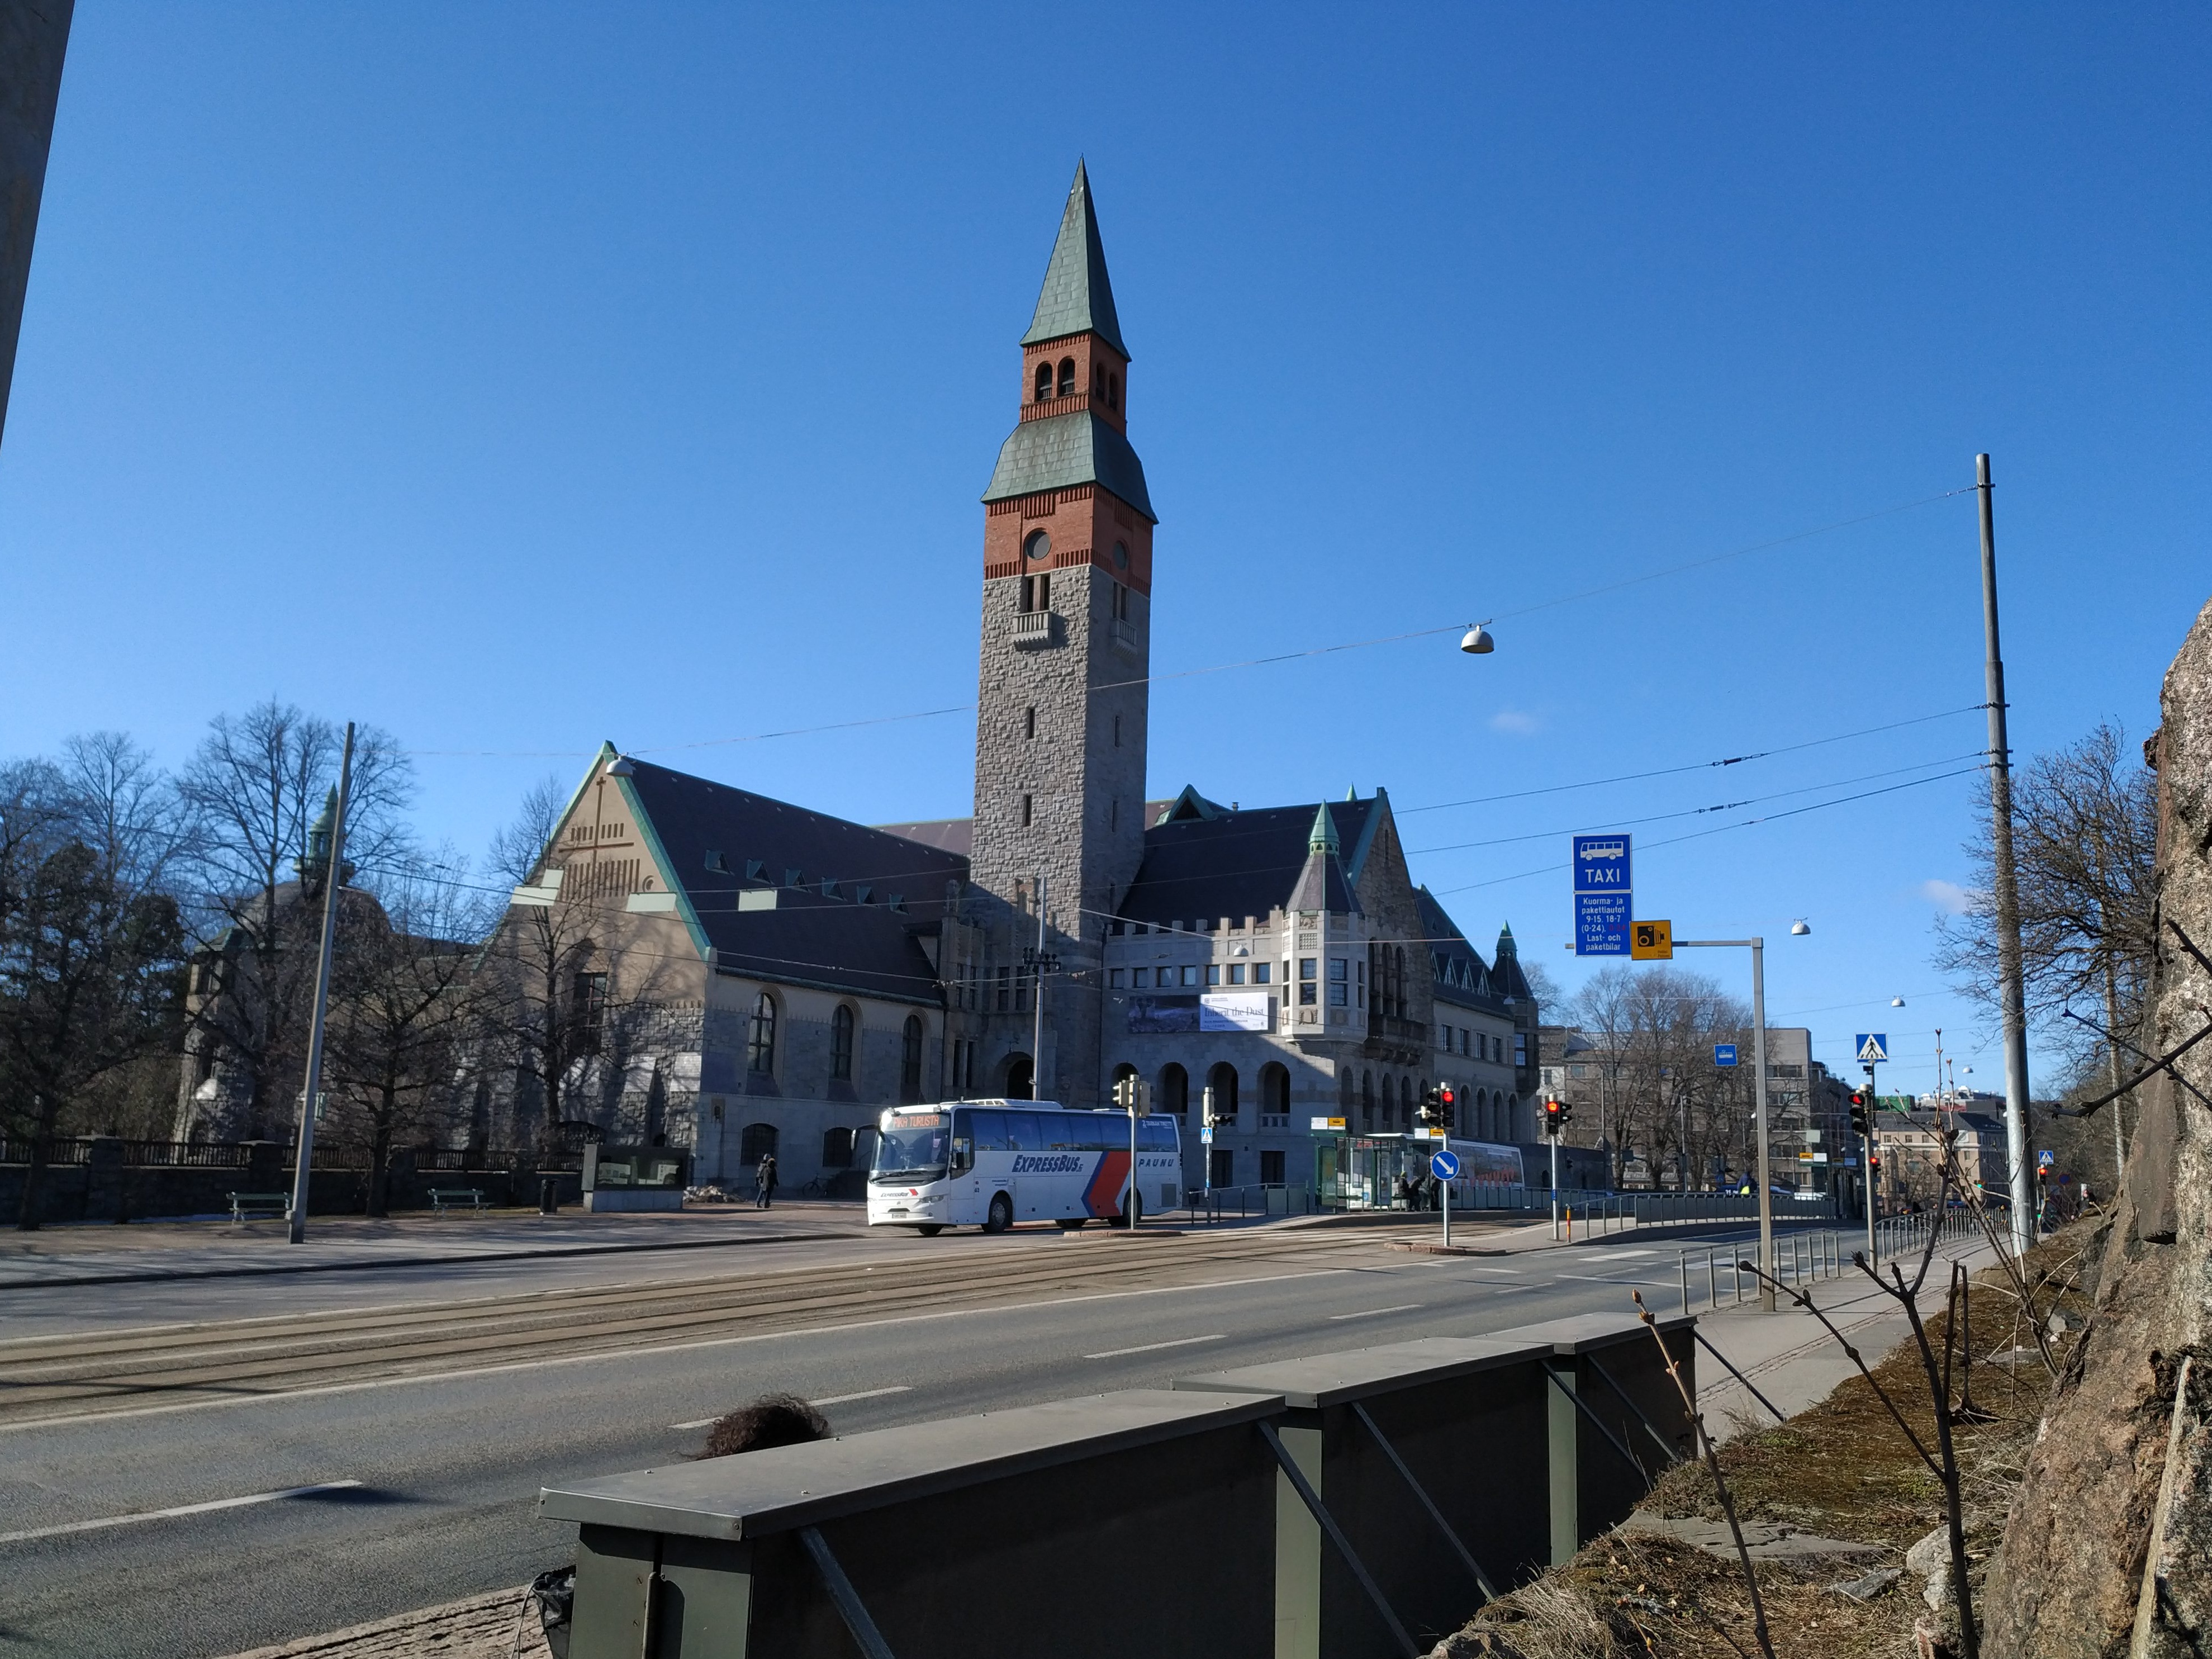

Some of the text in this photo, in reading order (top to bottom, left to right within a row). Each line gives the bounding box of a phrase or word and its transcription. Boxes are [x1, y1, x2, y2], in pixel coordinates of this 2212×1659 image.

[1585, 868, 1620, 883] TAXI
[1616, 897, 1623, 906] ja
[1582, 906, 1625, 915] pakettiautot
[1586, 942, 1621, 952] paketbilar
[1204, 1006, 1264, 1017] Inherit the Dust
[909, 1115, 939, 1127] TURUSTA
[1138, 1158, 1174, 1167] PAUNU
